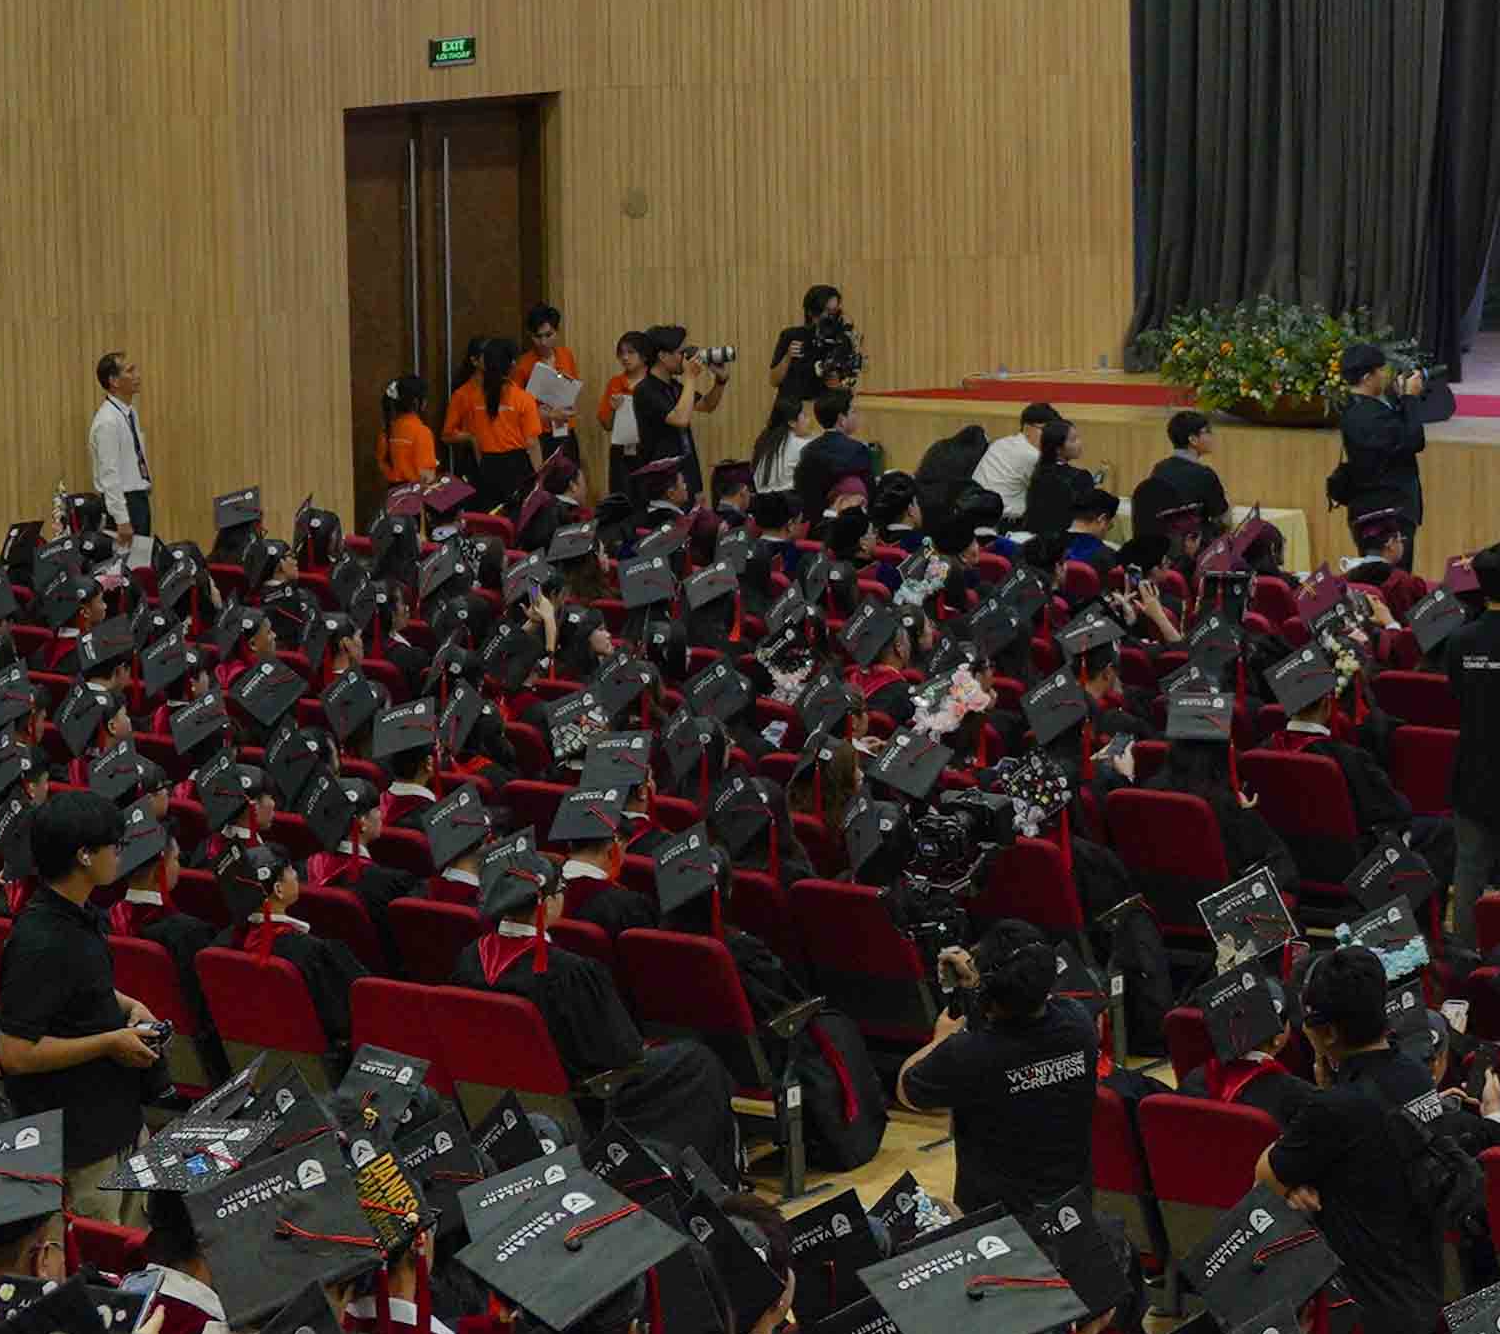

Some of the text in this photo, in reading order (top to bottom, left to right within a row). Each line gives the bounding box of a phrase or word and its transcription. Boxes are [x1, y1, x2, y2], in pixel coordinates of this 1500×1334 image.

[442, 40, 465, 52] EXIT
[1021, 1066, 1086, 1090] CREATION
[216, 1175, 299, 1220] VANLANG
[221, 1170, 284, 1207] UNIVERSITY
[480, 1177, 544, 1208] VANLANG
[496, 1206, 567, 1263] VANLANG
[1204, 1216, 1255, 1281] VANLANG
[898, 1249, 978, 1291] VANLANG
